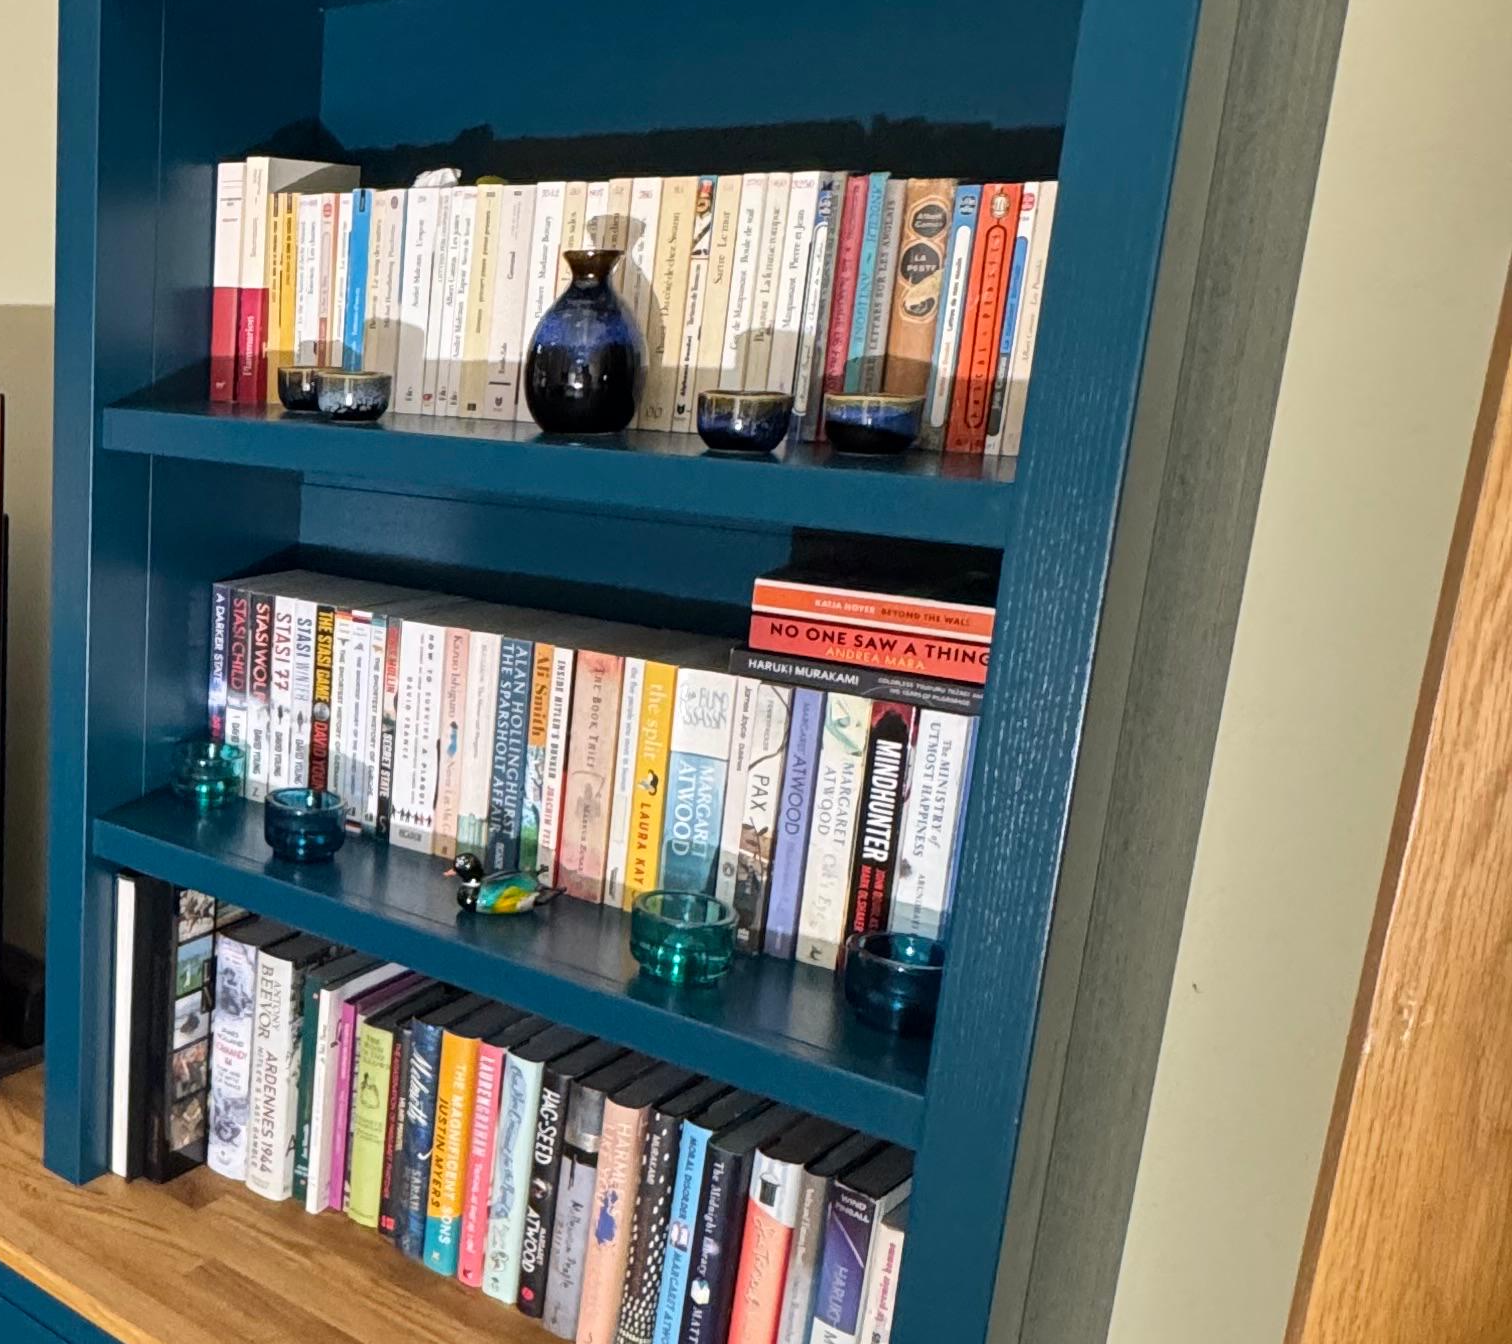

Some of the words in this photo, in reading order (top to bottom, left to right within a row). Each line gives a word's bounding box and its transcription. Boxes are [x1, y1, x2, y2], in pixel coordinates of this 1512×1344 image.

[669, 213, 681, 244] Swann
[742, 225, 752, 236] de
[794, 210, 805, 231] Jean
[881, 200, 896, 247] ANGLAIS
[667, 246, 677, 267] chez
[716, 237, 726, 248] Le
[739, 239, 751, 263] Boule
[789, 243, 802, 270] Pierre
[878, 251, 889, 271] LES
[713, 255, 725, 284] Sartre
[760, 282, 771, 293] La
[875, 275, 886, 298] SUR
[659, 302, 670, 317] Du
[663, 280, 673, 301] côté
[733, 270, 748, 318] Maupassant
[783, 277, 797, 328] Maupassant
[854, 273, 873, 344] ANTIGONE
[870, 300, 885, 350] LETTRES
[242, 315, 256, 376] Flammarion
[214, 605, 225, 650] DARKER
[232, 598, 247, 638] STASI
[255, 602, 270, 648] STASI
[318, 612, 334, 637] THE
[814, 599, 843, 610] KATJA
[845, 602, 876, 614] HOYER
[880, 608, 921, 620] BEYOND
[923, 612, 942, 622] THE
[275, 612, 292, 663] STASI
[296, 618, 313, 657] STASI
[316, 639, 333, 666] STASI
[451, 634, 464, 670] Kazuo
[770, 622, 799, 638] NO
[805, 628, 847, 645] ONE
[854, 634, 898, 652] SAW
[904, 642, 918, 656] A
[924, 644, 990, 667] THING
[213, 653, 224, 684] STATE
[230, 642, 246, 689] CHILD
[501, 644, 514, 673] THE
[513, 646, 529, 693] ALAN
[536, 652, 551, 678] Ali
[554, 660, 567, 692] INSIDE
[630, 667, 640, 679] the
[748, 659, 793, 676] HARUKI
[795, 666, 860, 687] MURAKAMI
[825, 646, 881, 665] ANDREA
[884, 654, 926, 670] MARA
[274, 670, 289, 691] 77
[295, 662, 311, 701] WINTER
[314, 669, 331, 702] GAME
[449, 672, 462, 718] Ishiguro
[647, 684, 668, 715] the
[742, 686, 754, 712] James
[494, 679, 513, 772] SPARSHOLT
[531, 683, 549, 737] Smith
[551, 696, 564, 739] HITLER'S
[738, 713, 750, 739] Joyce
[313, 721, 329, 757] DAVID
[381, 733, 393, 768] SECRET
[401, 717, 411, 760] FRANCE
[643, 718, 663, 762] split
[922, 722, 941, 783] UTMOST
[940, 740, 953, 757] The
[251, 751, 261, 775] YOUNG
[502, 701, 526, 838] HOLLINGHURST
[548, 743, 561, 780] BUNKER
[379, 770, 391, 798] STATE
[749, 774, 771, 812] PAX
[784, 754, 810, 835] ATWOOD
[817, 766, 838, 836] ATWOOD
[861, 739, 902, 862] MINDHUNTER
[931, 759, 951, 832] MINISTRY
[489, 776, 507, 833] AFFAIR
[544, 784, 558, 825] JOACHIM
[671, 760, 697, 856] ATWOOD
[693, 765, 715, 858] MARGARET
[832, 762, 855, 846] MARGARET
[913, 785, 932, 858] HAPPINESS
[541, 829, 554, 850] FEST
[636, 802, 652, 850] LAURA
[928, 835, 941, 849] of
[632, 859, 647, 886] KAY
[858, 864, 871, 889] MARK
[874, 868, 886, 889] JOHN
[854, 891, 868, 932] OLSHAKER
[257, 963, 275, 1039] BEEVOR
[271, 980, 283, 1031] ANTONY
[260, 1050, 278, 1138] ARDENNES
[406, 1046, 433, 1126] Melmoth
[454, 1064, 467, 1088] THE
[435, 1097, 449, 1150] JUSTIN
[535, 1087, 561, 1164] HAG-SEED
[259, 1141, 273, 1174] 1944
[444, 1094, 464, 1201] MAGNIFICENT
[646, 1134, 661, 1185] MURAKAMI
[684, 1136, 697, 1171] MORAL
[431, 1154, 445, 1208] MYERS
[712, 1161, 725, 1181] The
[678, 1173, 693, 1221] DISORDER
[704, 1184, 722, 1233] Midnight
[438, 1205, 452, 1245] SONS
[521, 1206, 541, 1273] ATWOOD
[696, 1236, 716, 1278] Library
[881, 1242, 896, 1274] homme
[665, 1252, 683, 1310] MARGARET
[828, 1265, 849, 1329] HARUKI
[877, 1276, 891, 1311] premier
[688, 1306, 703, 1344] MATT
